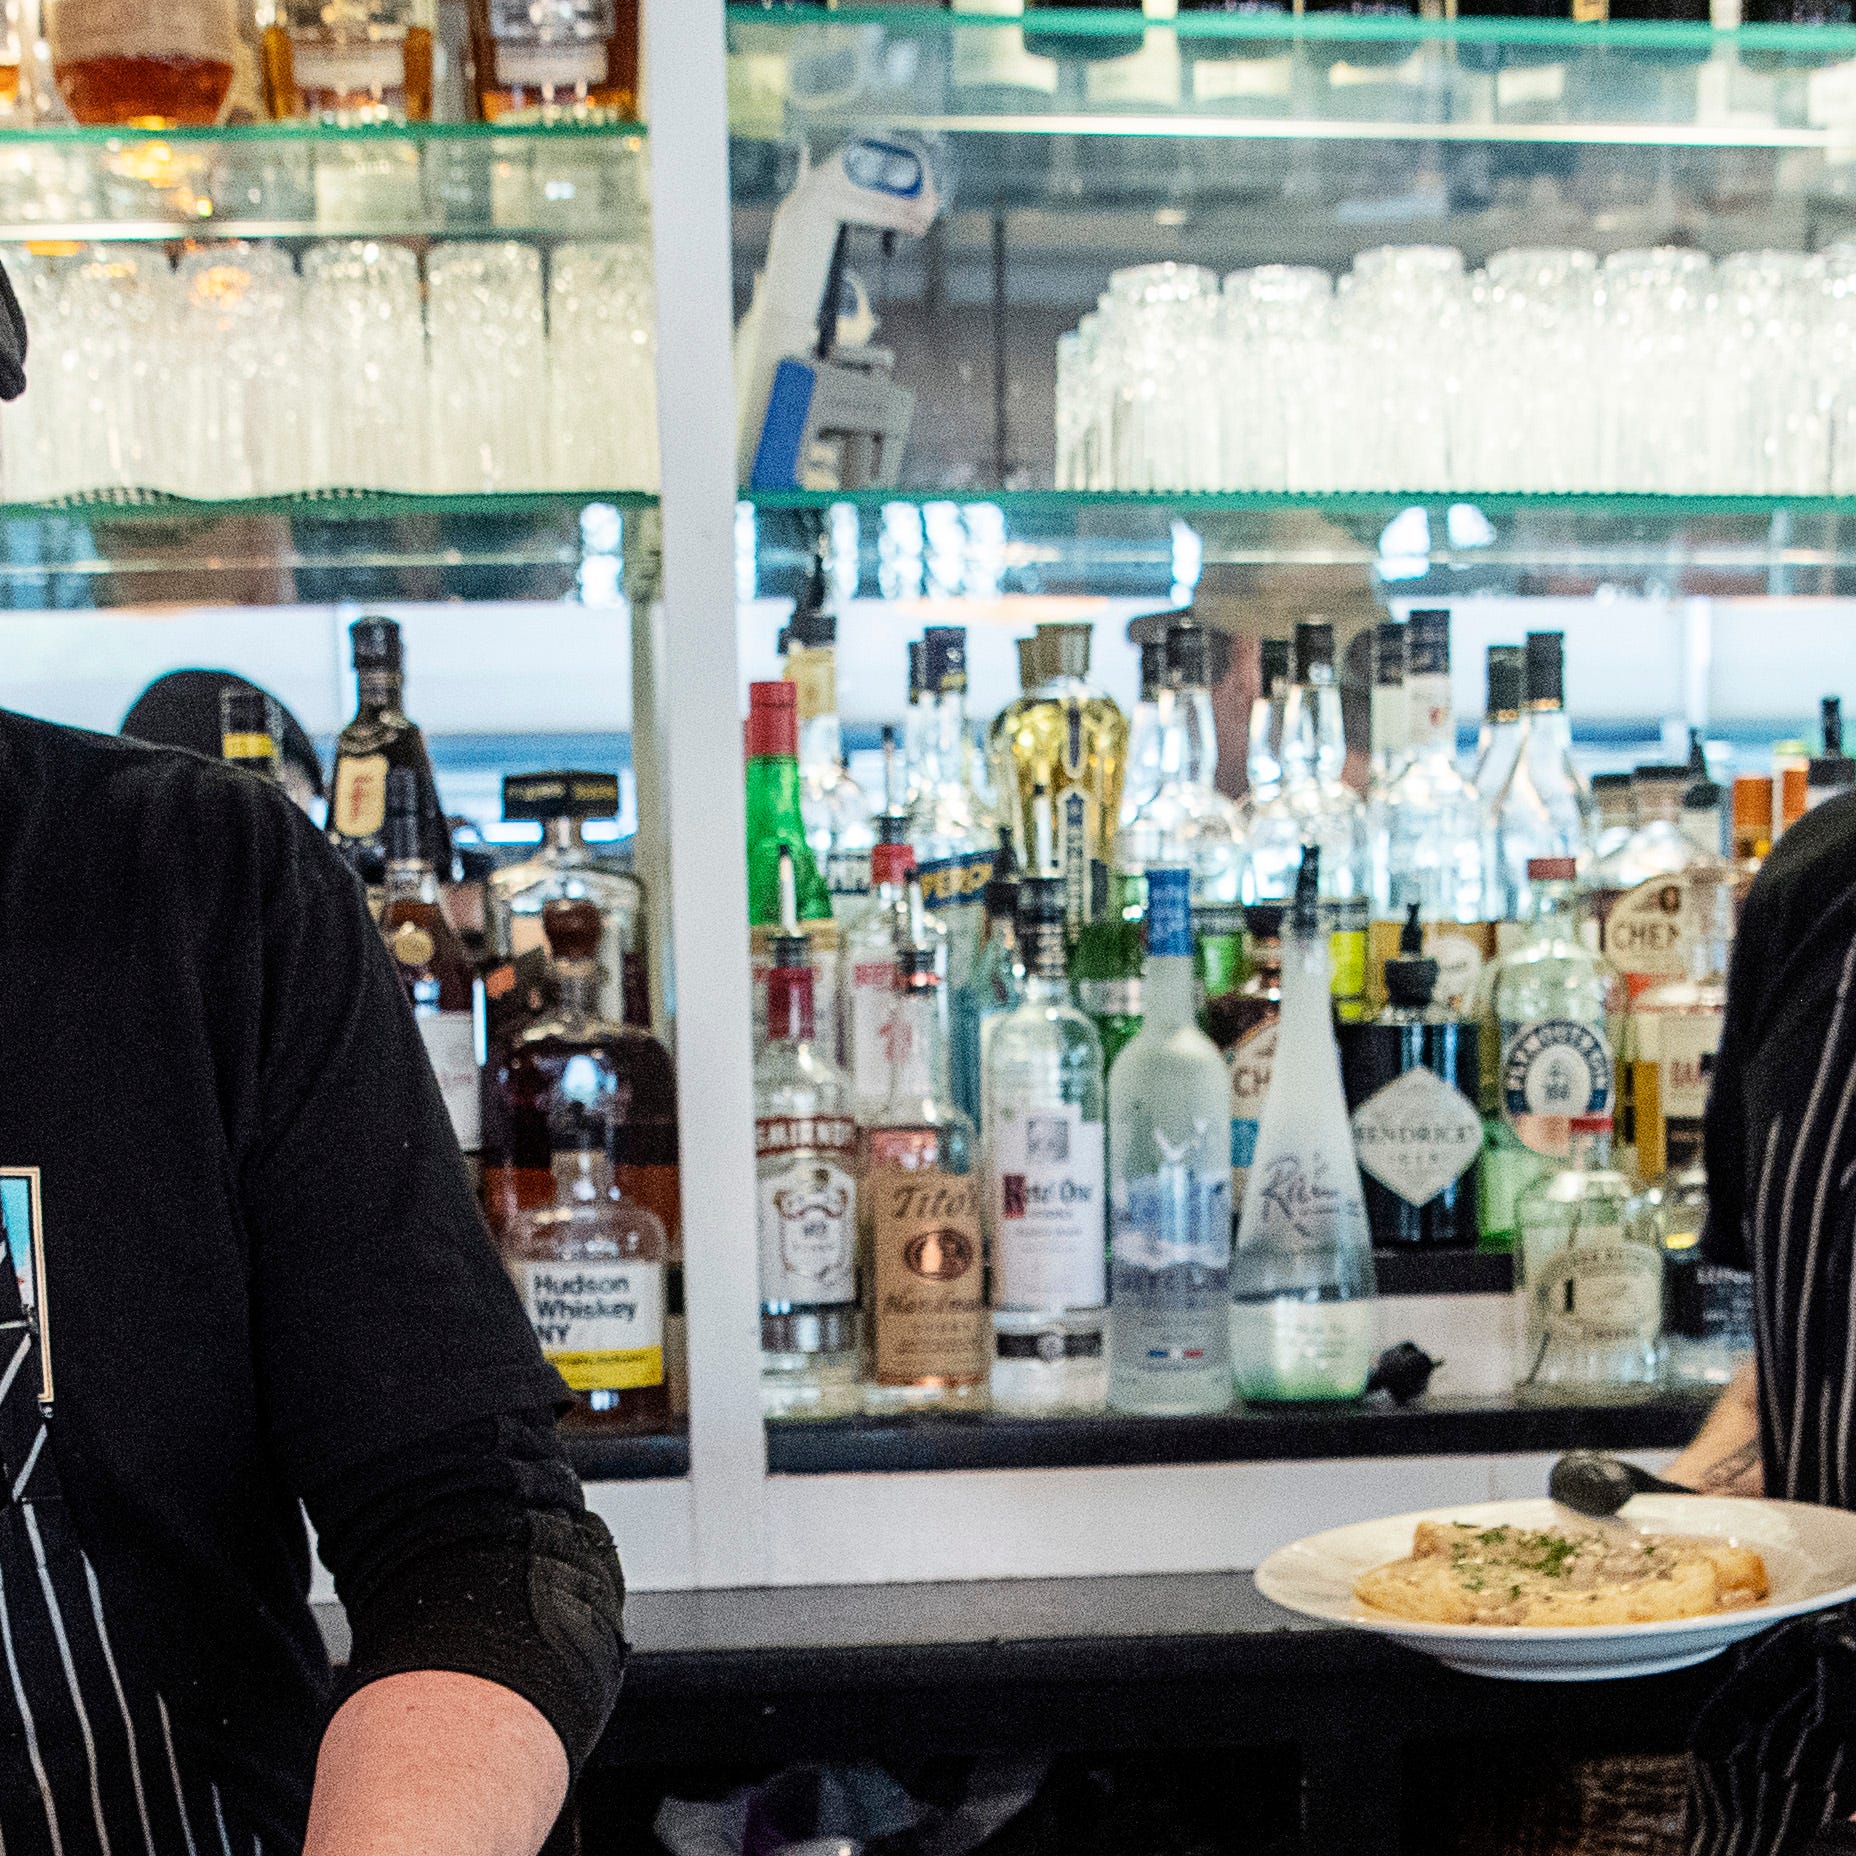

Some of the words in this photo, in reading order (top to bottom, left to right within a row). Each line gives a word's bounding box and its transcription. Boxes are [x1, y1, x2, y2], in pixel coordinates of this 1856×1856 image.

[533, 1273, 629, 1295] Hudson
[535, 1300, 636, 1322] Whiskey
[535, 1323, 570, 1345] NY
